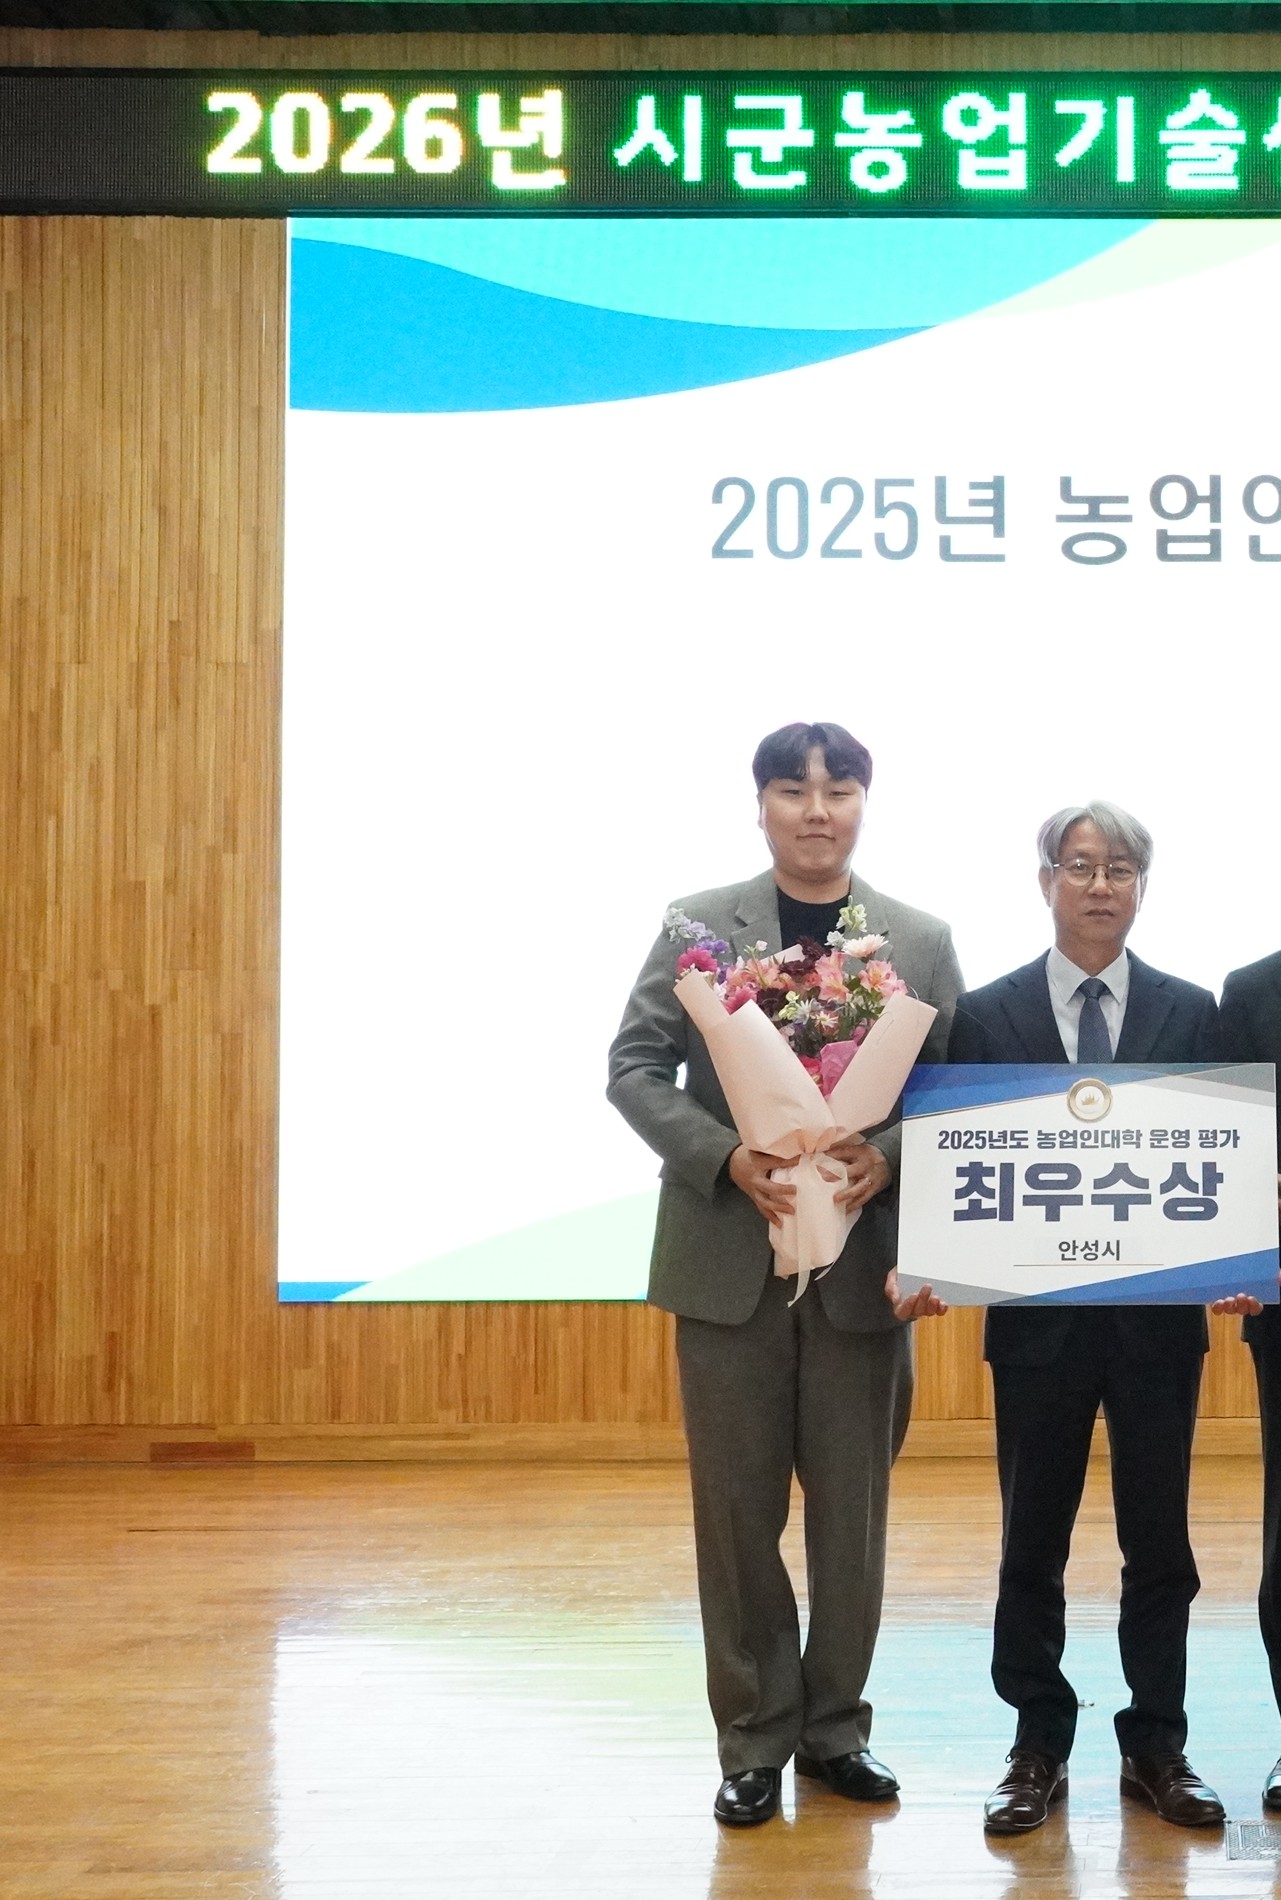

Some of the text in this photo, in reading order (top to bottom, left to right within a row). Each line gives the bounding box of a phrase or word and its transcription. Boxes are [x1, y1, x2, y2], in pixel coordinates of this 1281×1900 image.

[206, 89, 567, 190] 2026년
[711, 475, 1006, 563] 2025년
[937, 1129, 1240, 1150] 2025년도 농업인대학 운영 평가
[953, 1161, 1224, 1222] 최우수상
[1058, 1239, 1121, 1262] 안성시
